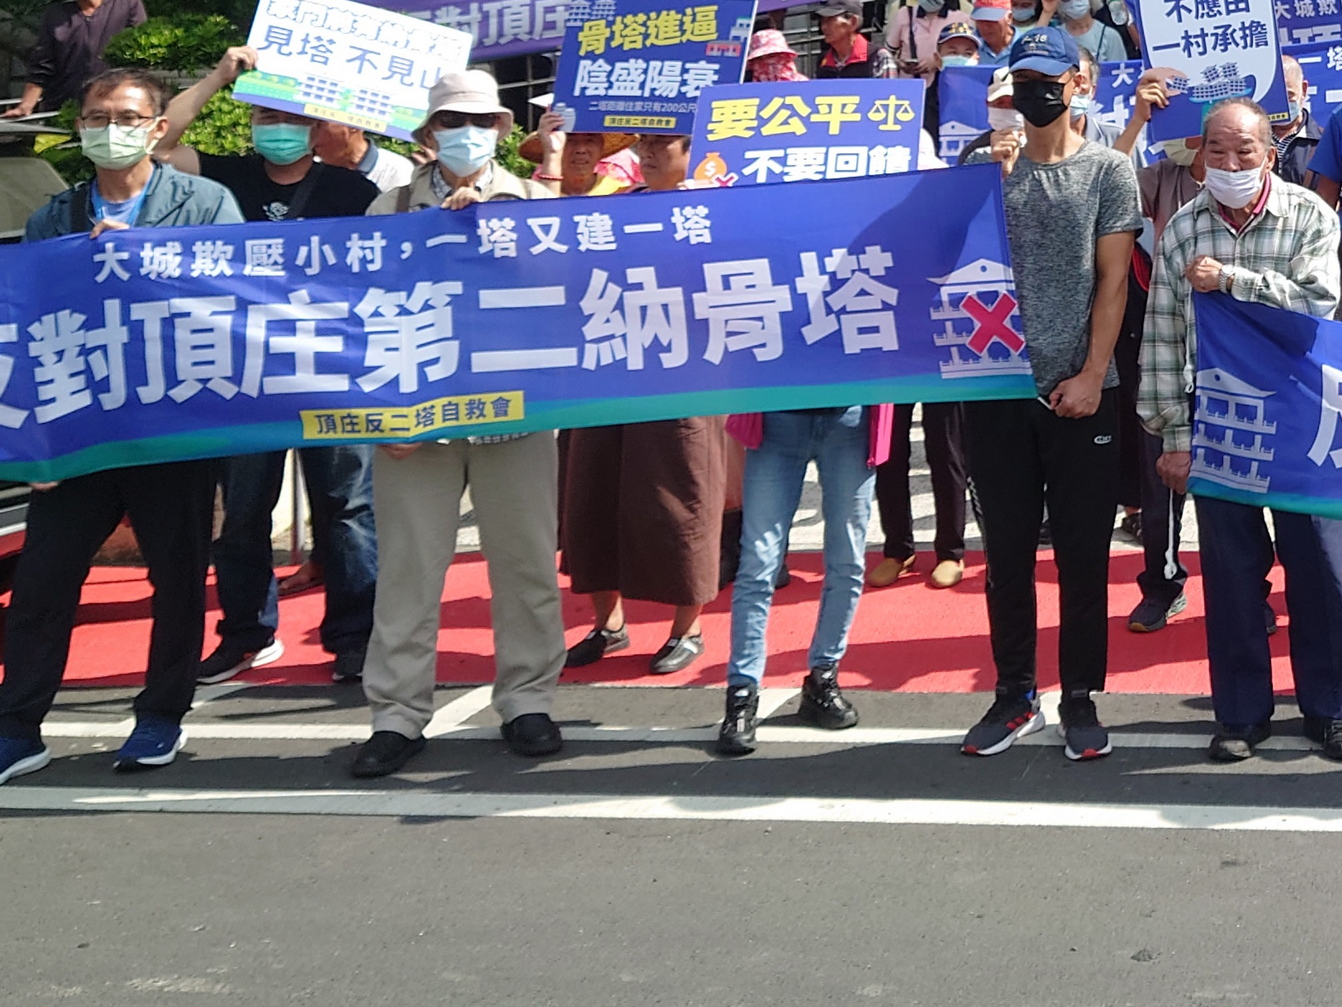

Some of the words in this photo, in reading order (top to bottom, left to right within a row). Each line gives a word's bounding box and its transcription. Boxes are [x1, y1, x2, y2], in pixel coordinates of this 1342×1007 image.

[257, 25, 337, 66] 見塔
[578, 5, 718, 56] 骨塔進逼
[1152, 20, 1268, 58] 一村承擔
[574, 58, 720, 99] 陰盛陽衰
[706, 96, 862, 141] 要公平
[742, 145, 911, 183] 不要回饋
[93, 205, 713, 283] 大城欺壓小村，一塔又建一塔
[316, 396, 512, 435] 頂庄反二塔自救會
